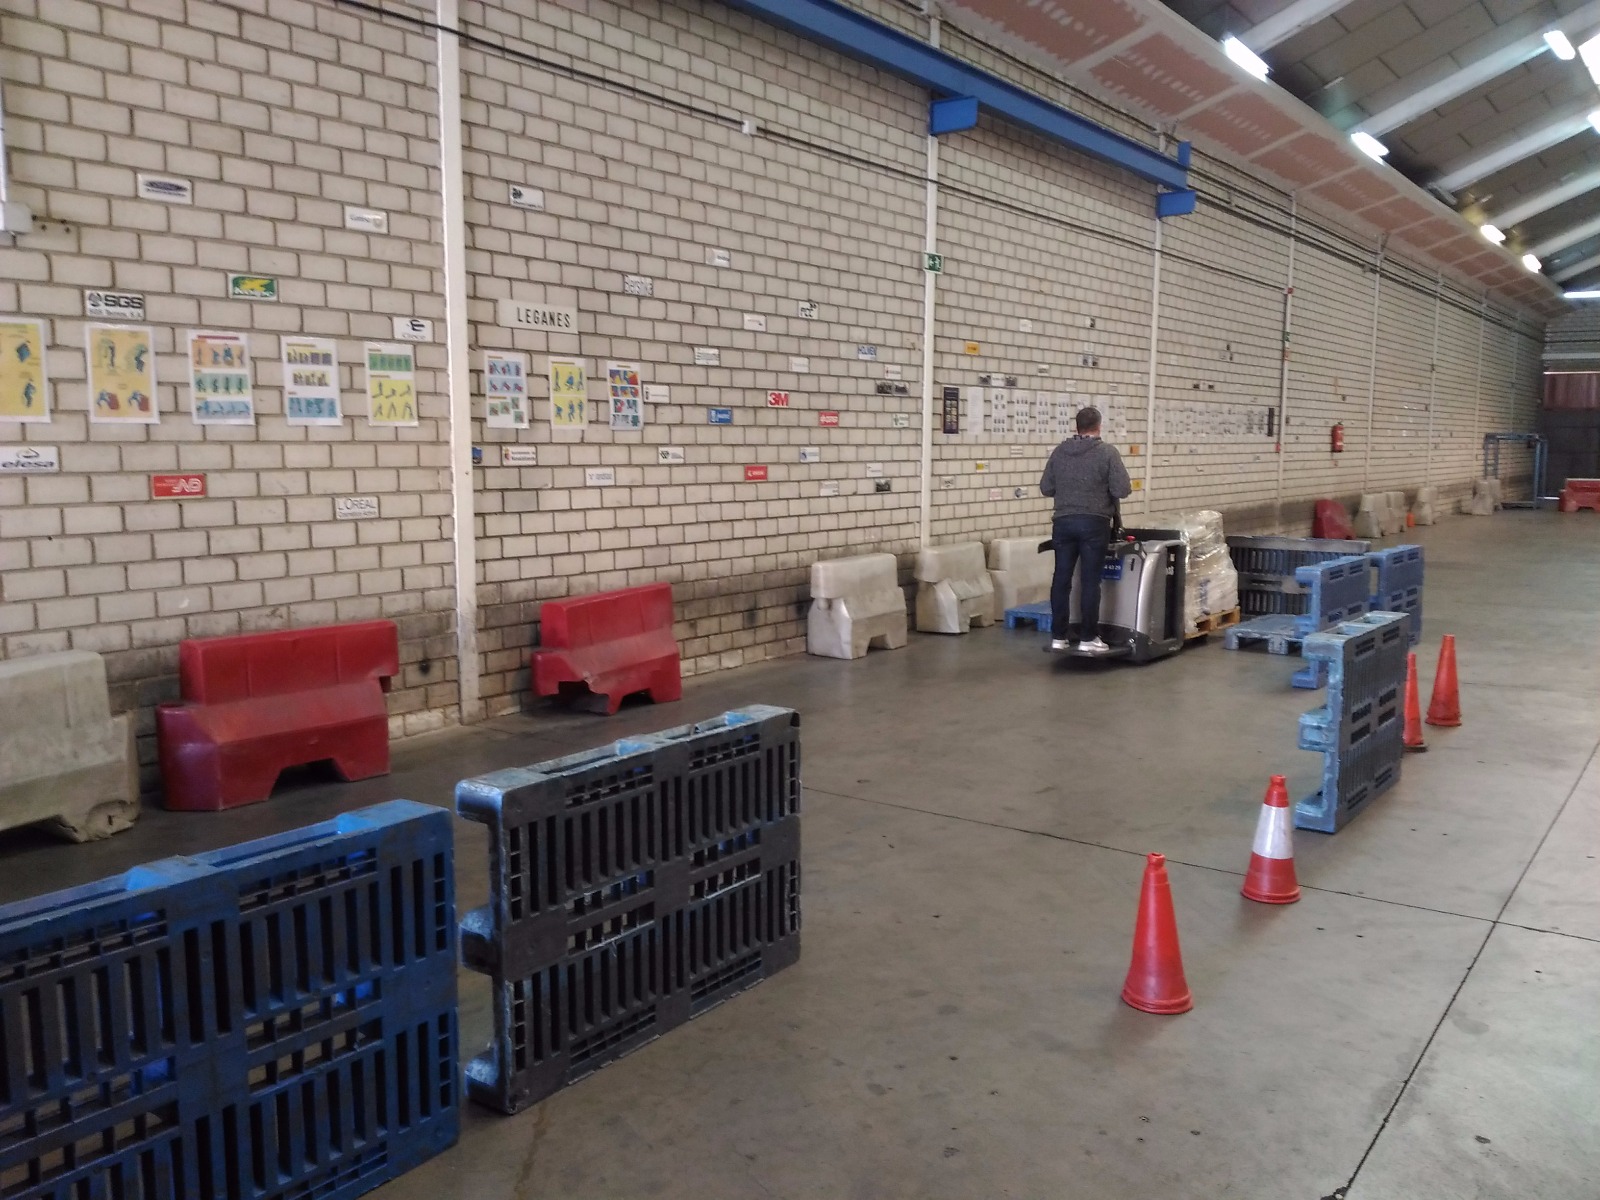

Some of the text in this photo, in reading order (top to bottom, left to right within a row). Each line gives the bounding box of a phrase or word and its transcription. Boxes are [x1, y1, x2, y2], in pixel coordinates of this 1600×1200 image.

[104, 294, 144, 310] SGS
[516, 306, 572, 328] LEGANES
[768, 391, 790, 408] 3M
